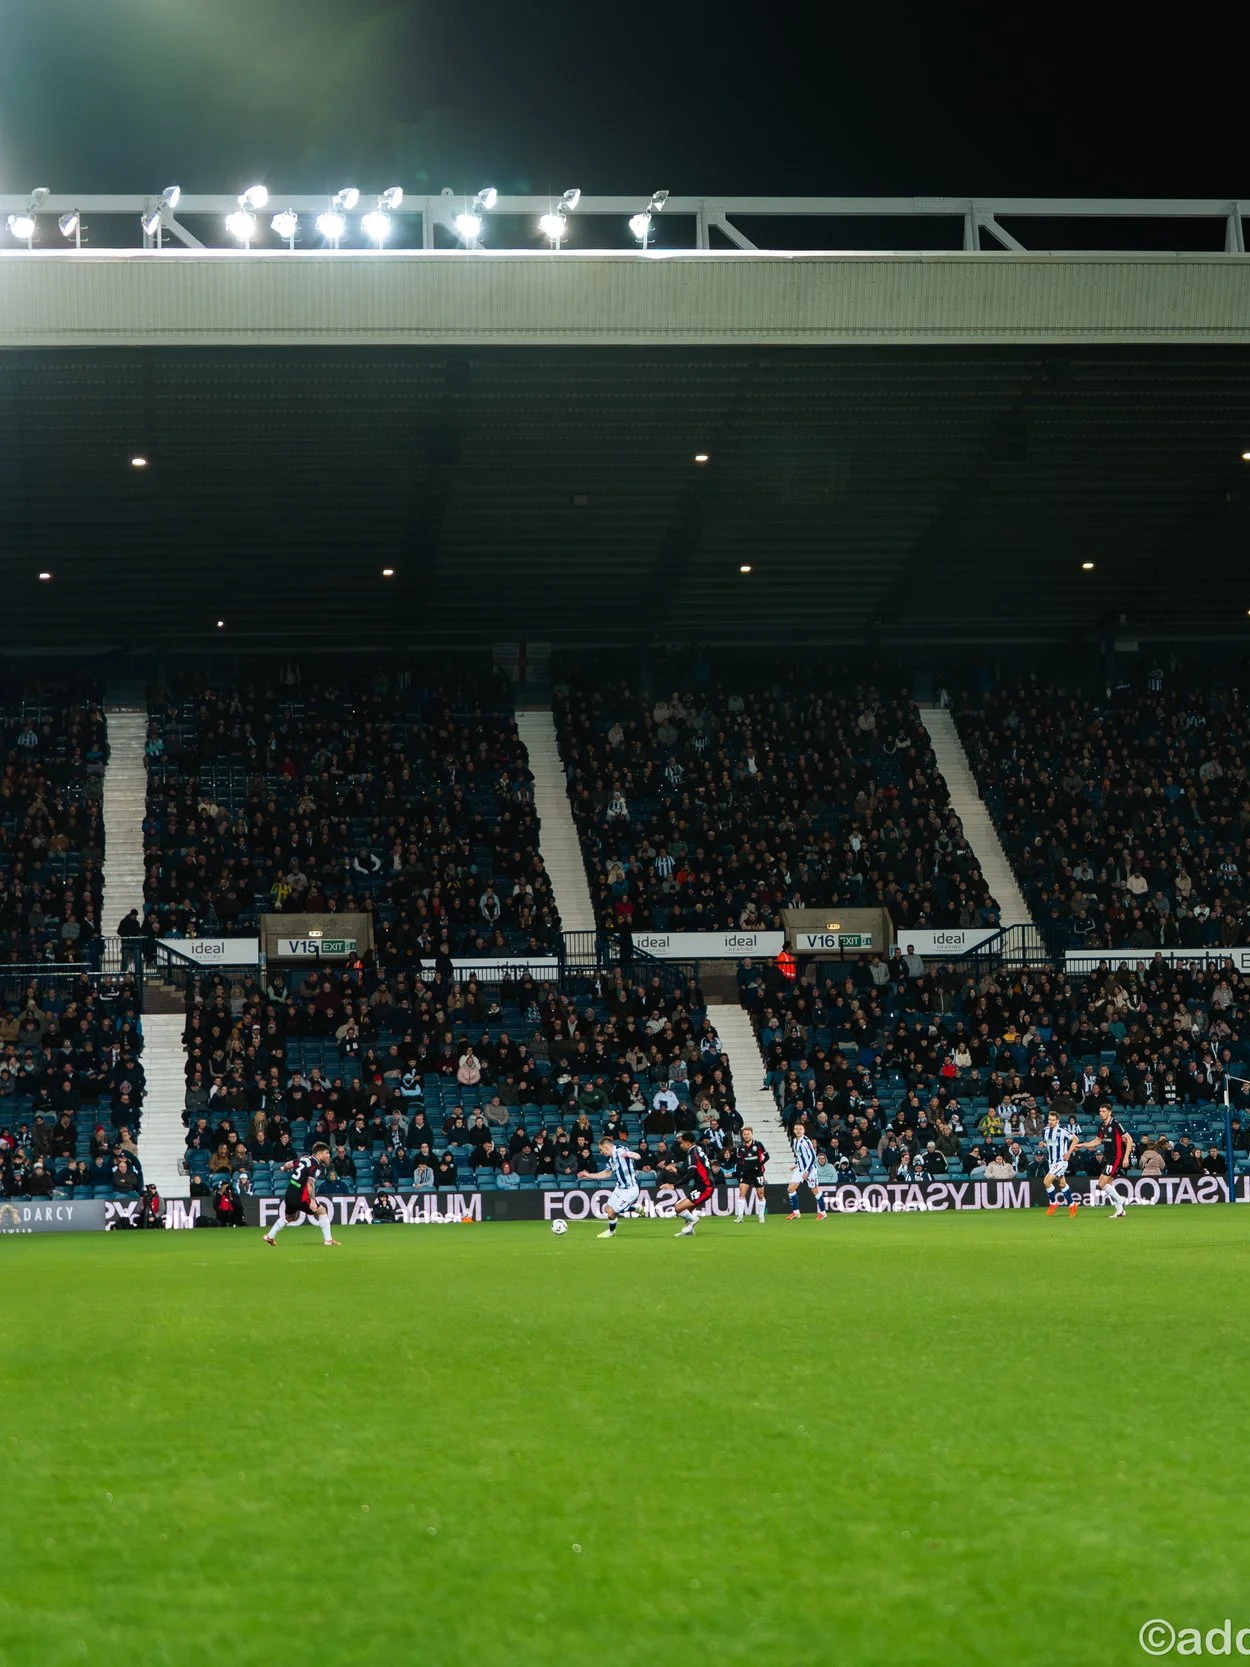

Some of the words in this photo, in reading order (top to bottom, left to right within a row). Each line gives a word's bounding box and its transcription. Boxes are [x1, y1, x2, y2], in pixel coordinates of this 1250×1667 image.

[637, 936, 669, 947] ideal
[725, 935, 756, 946] ideal
[807, 935, 835, 948] V16
[933, 932, 965, 944] ideal
[191, 942, 224, 954] ideal
[289, 940, 318, 954] V15
[322, 942, 344, 951] EXIT
[291, 1162, 306, 1181] 3
[23, 1206, 73, 1221] DARCY
